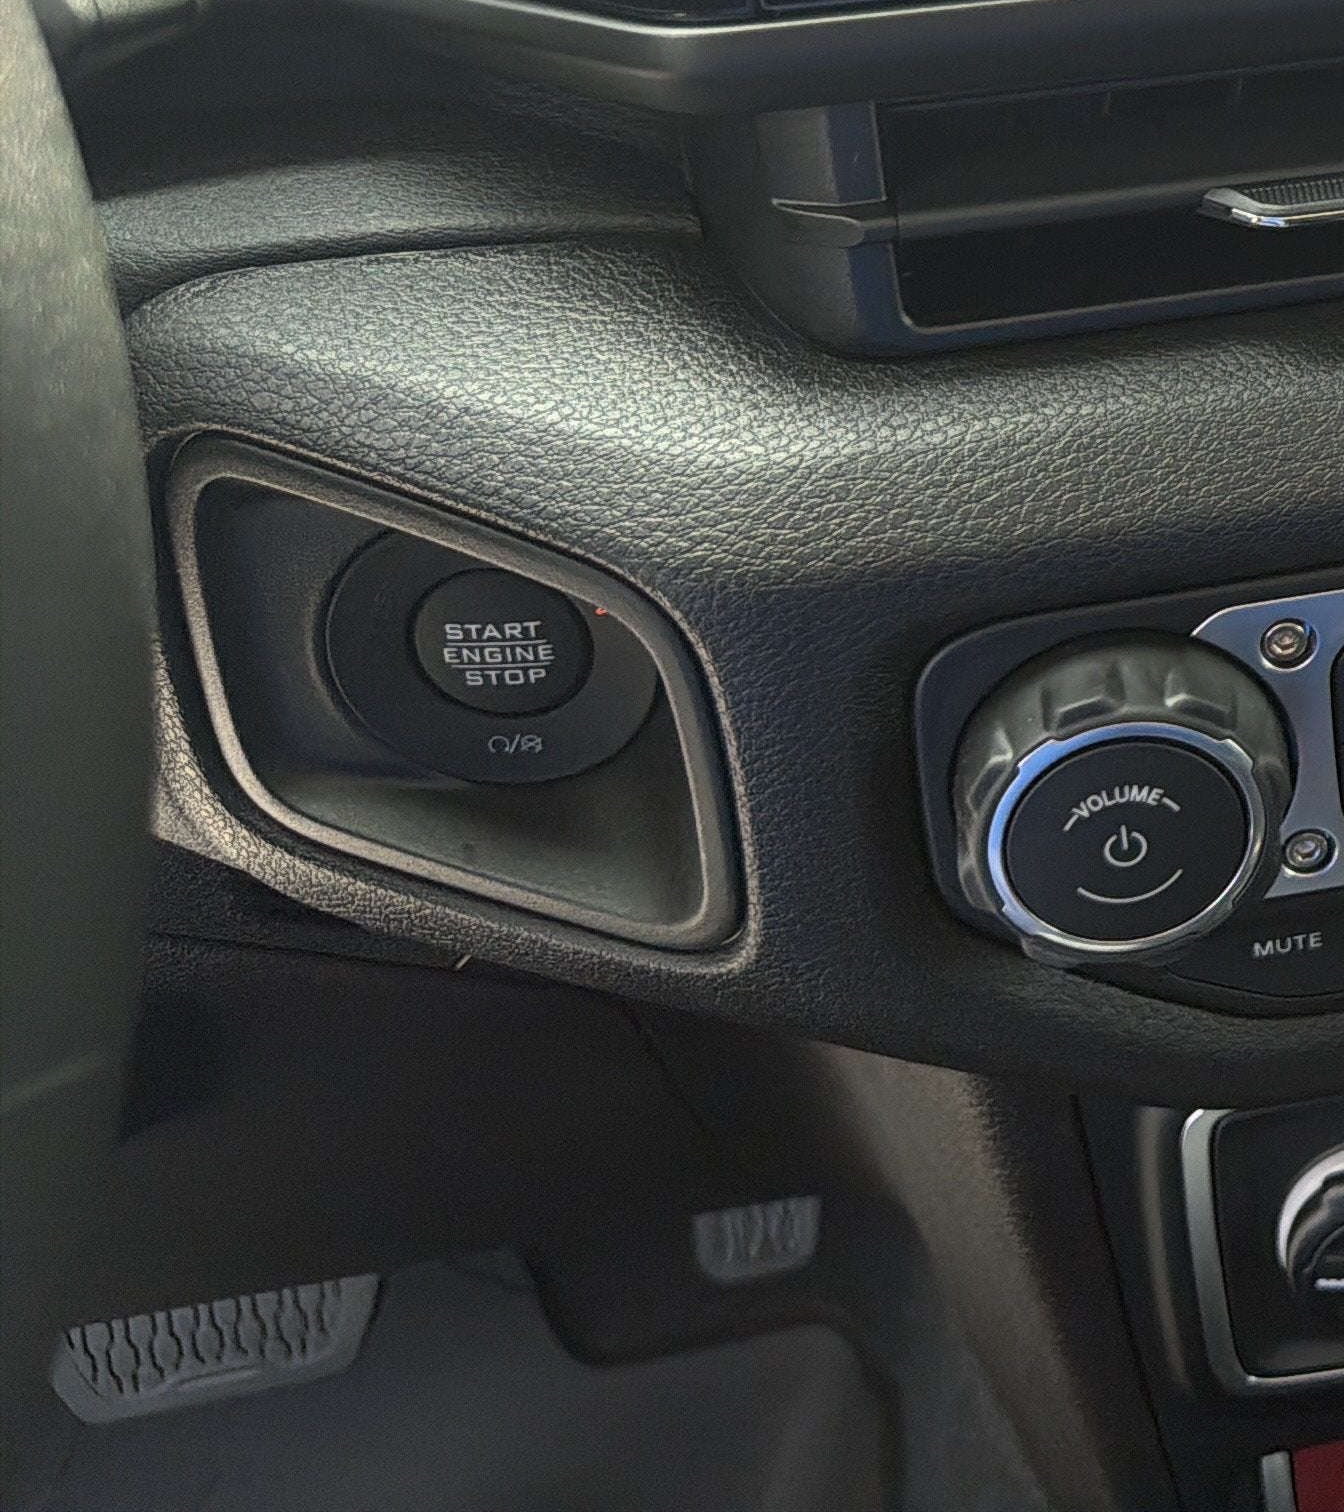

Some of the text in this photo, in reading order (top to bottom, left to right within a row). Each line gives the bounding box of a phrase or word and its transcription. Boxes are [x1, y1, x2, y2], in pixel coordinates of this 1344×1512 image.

[445, 621, 541, 640] START
[443, 644, 556, 664] ENGINE
[465, 668, 548, 686] STOP
[1071, 785, 1165, 819] VOLUME
[1253, 931, 1324, 959] MUTE
